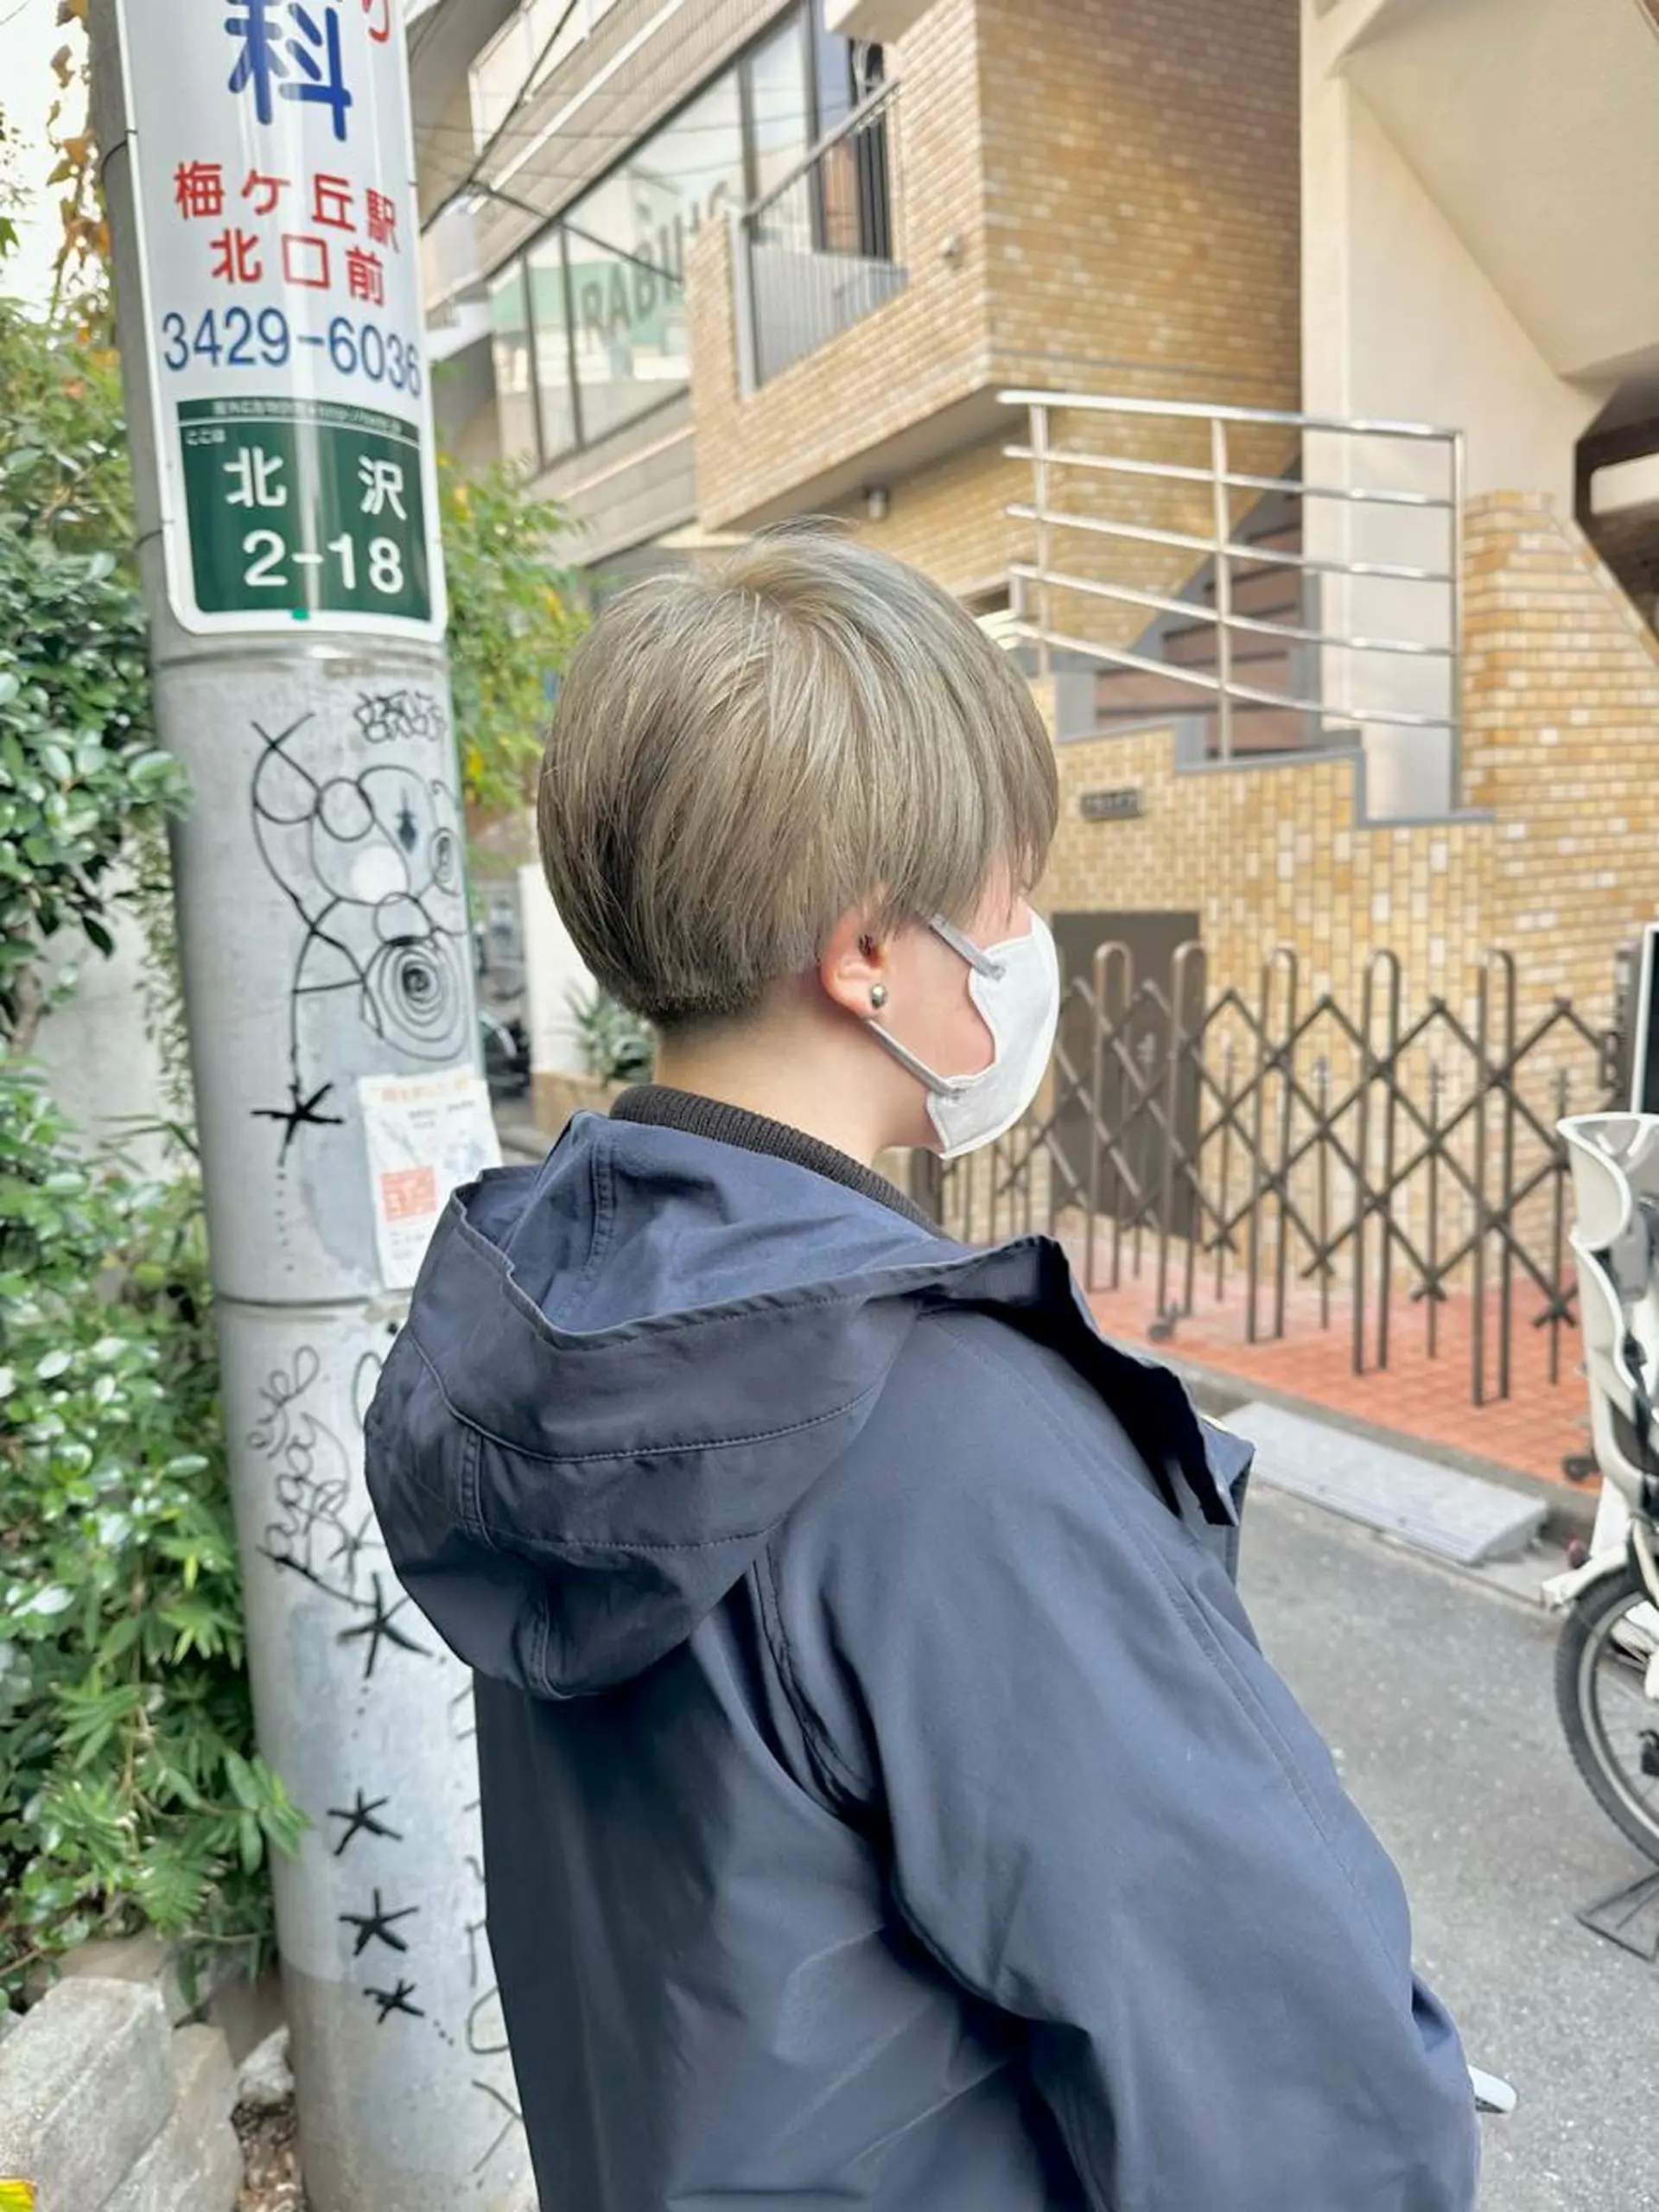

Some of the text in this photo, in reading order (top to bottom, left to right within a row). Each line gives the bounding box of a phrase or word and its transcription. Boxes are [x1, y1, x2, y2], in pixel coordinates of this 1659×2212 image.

[210, 228, 385, 308] 北口前
[162, 306, 423, 400] 3429-6036
[242, 529, 405, 594] 2-18
